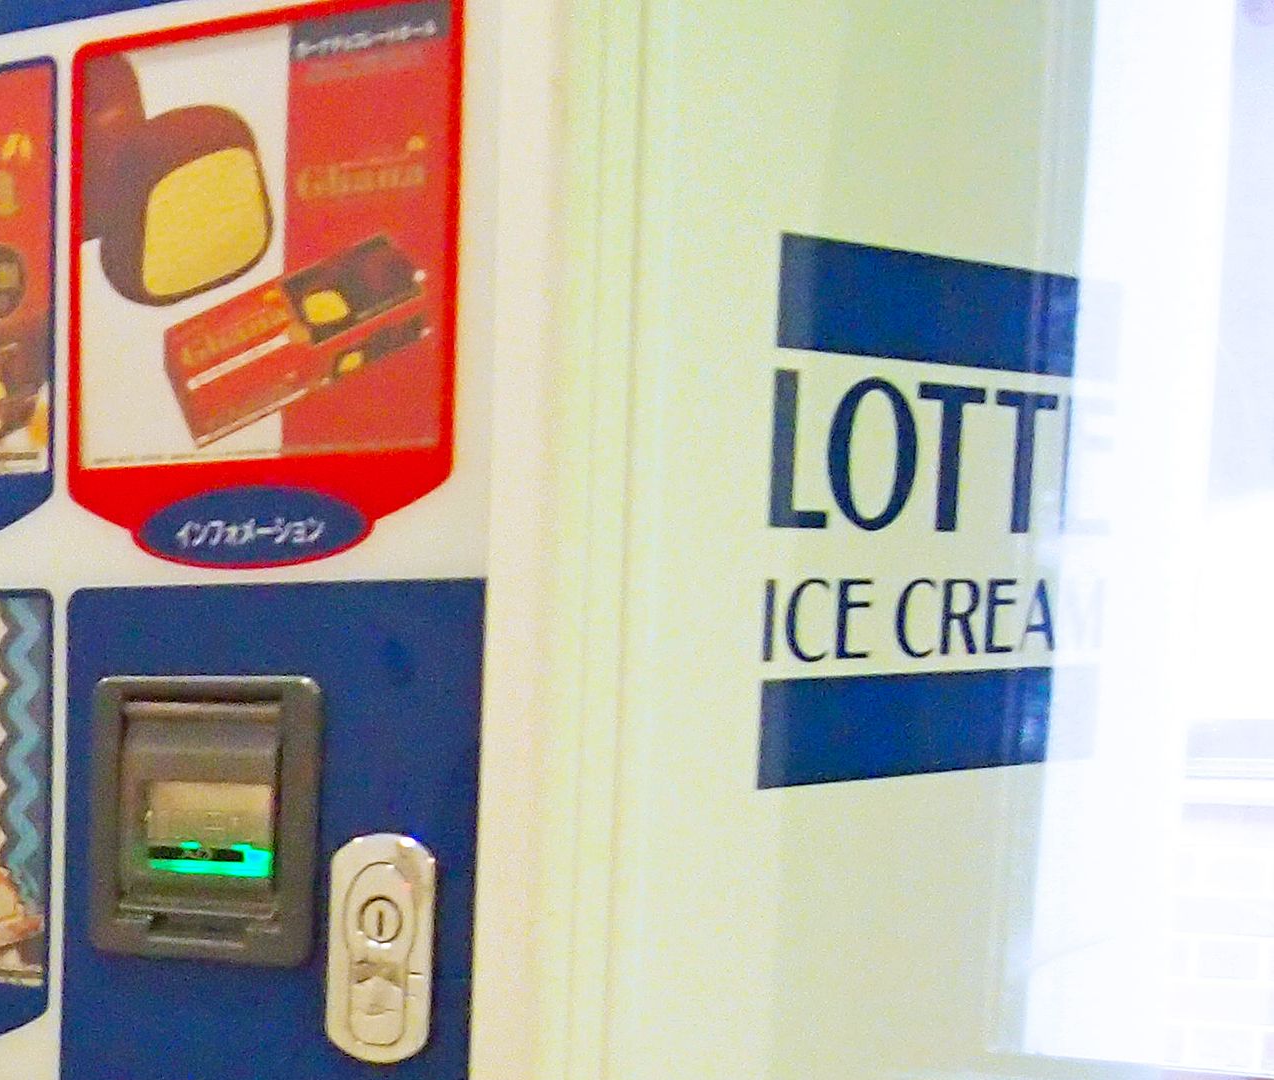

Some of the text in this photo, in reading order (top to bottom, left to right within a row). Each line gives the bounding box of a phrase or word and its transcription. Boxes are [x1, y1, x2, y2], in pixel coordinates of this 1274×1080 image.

[295, 162, 427, 199] Ghana
[176, 518, 327, 547] インフォメーション
[762, 578, 874, 662] ICE
